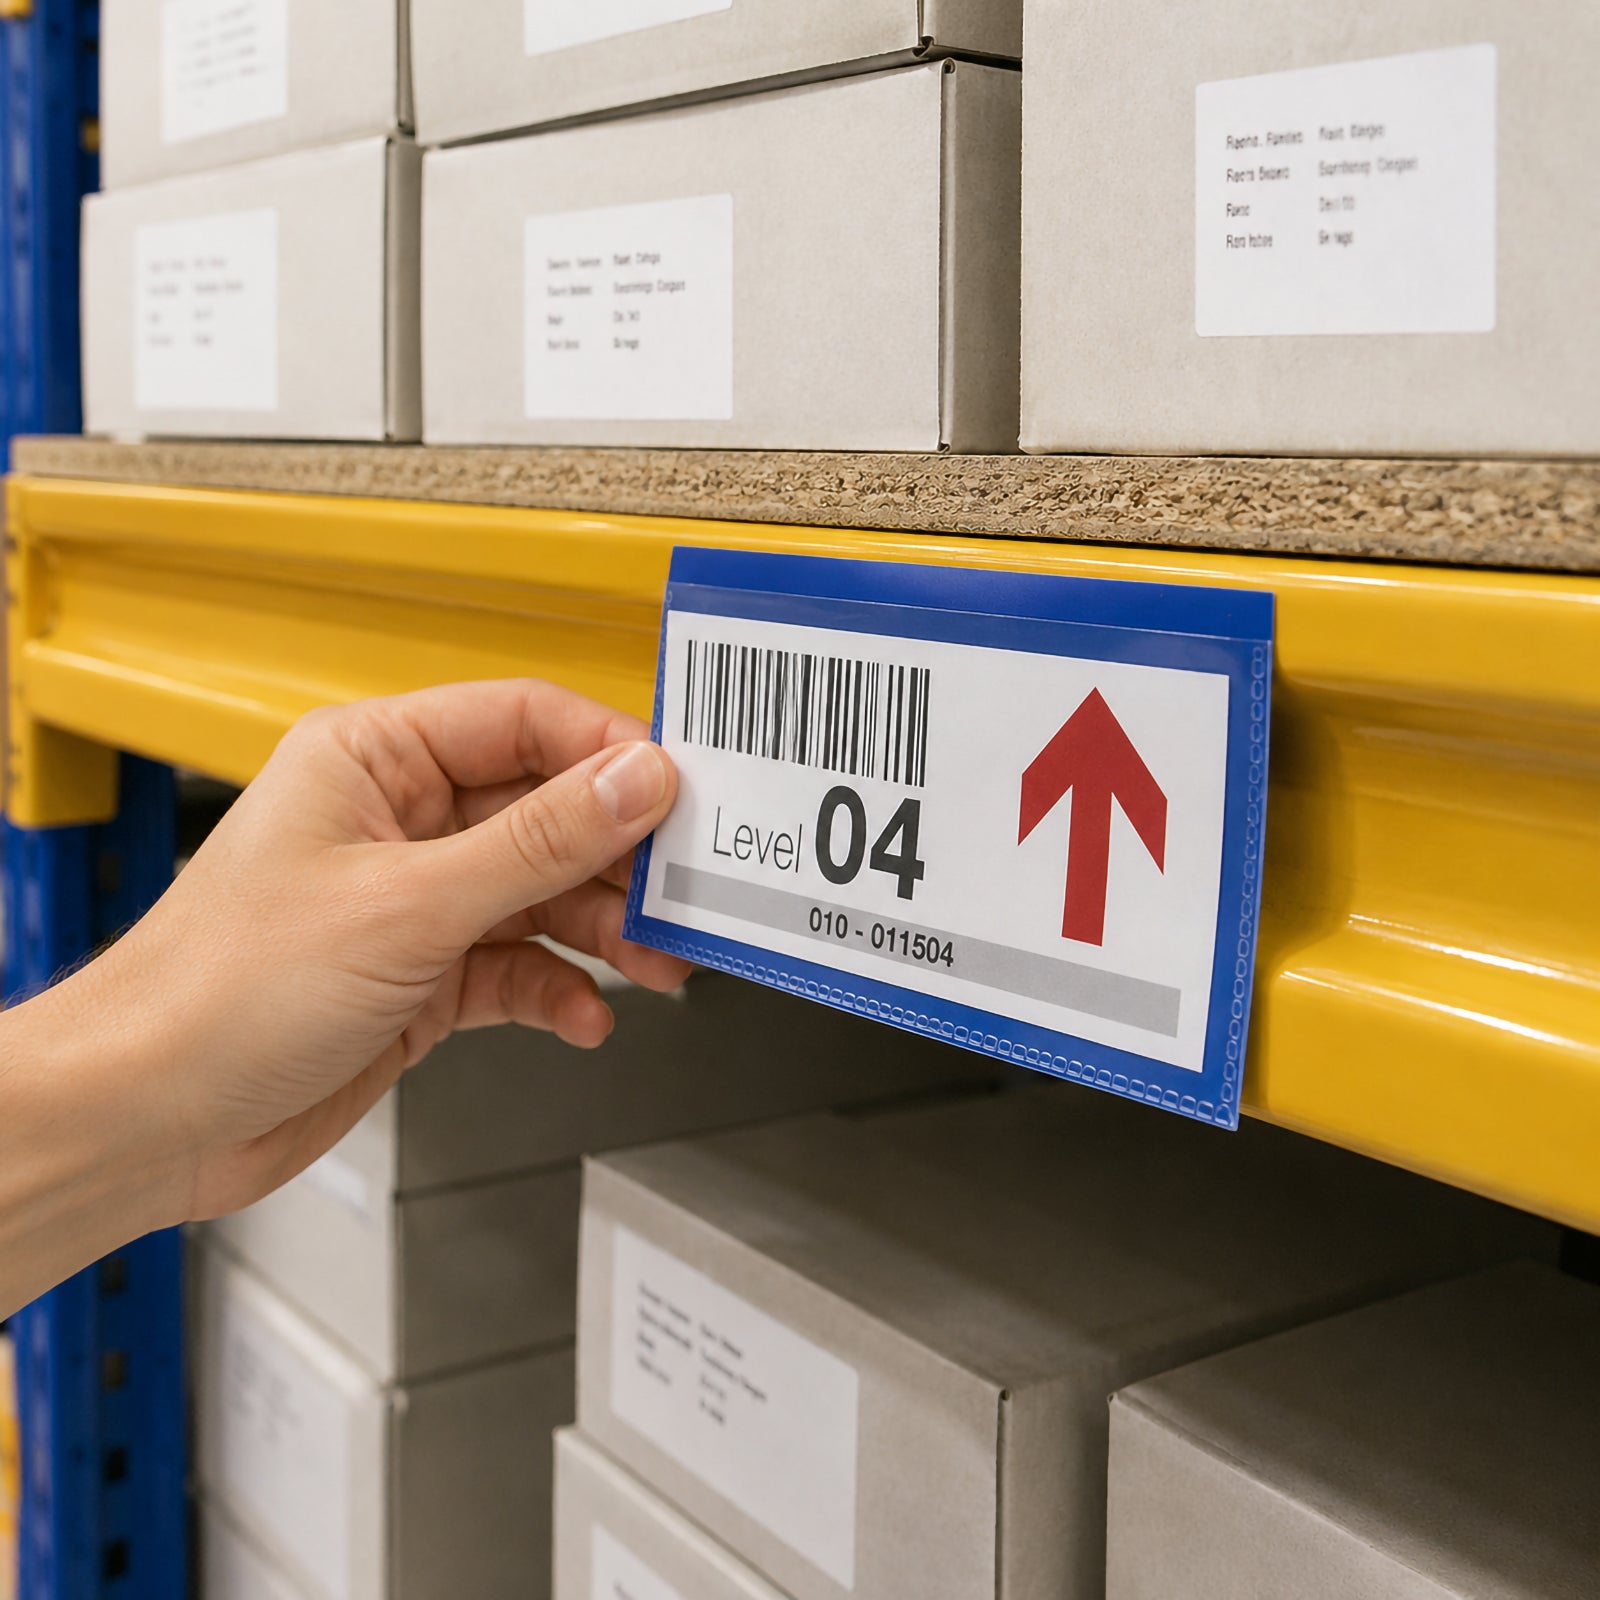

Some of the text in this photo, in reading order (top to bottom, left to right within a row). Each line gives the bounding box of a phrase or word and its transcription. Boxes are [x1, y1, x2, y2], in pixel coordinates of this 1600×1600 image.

[713, 785, 925, 900] Level 04
[809, 906, 955, 968] 010 - 011504
